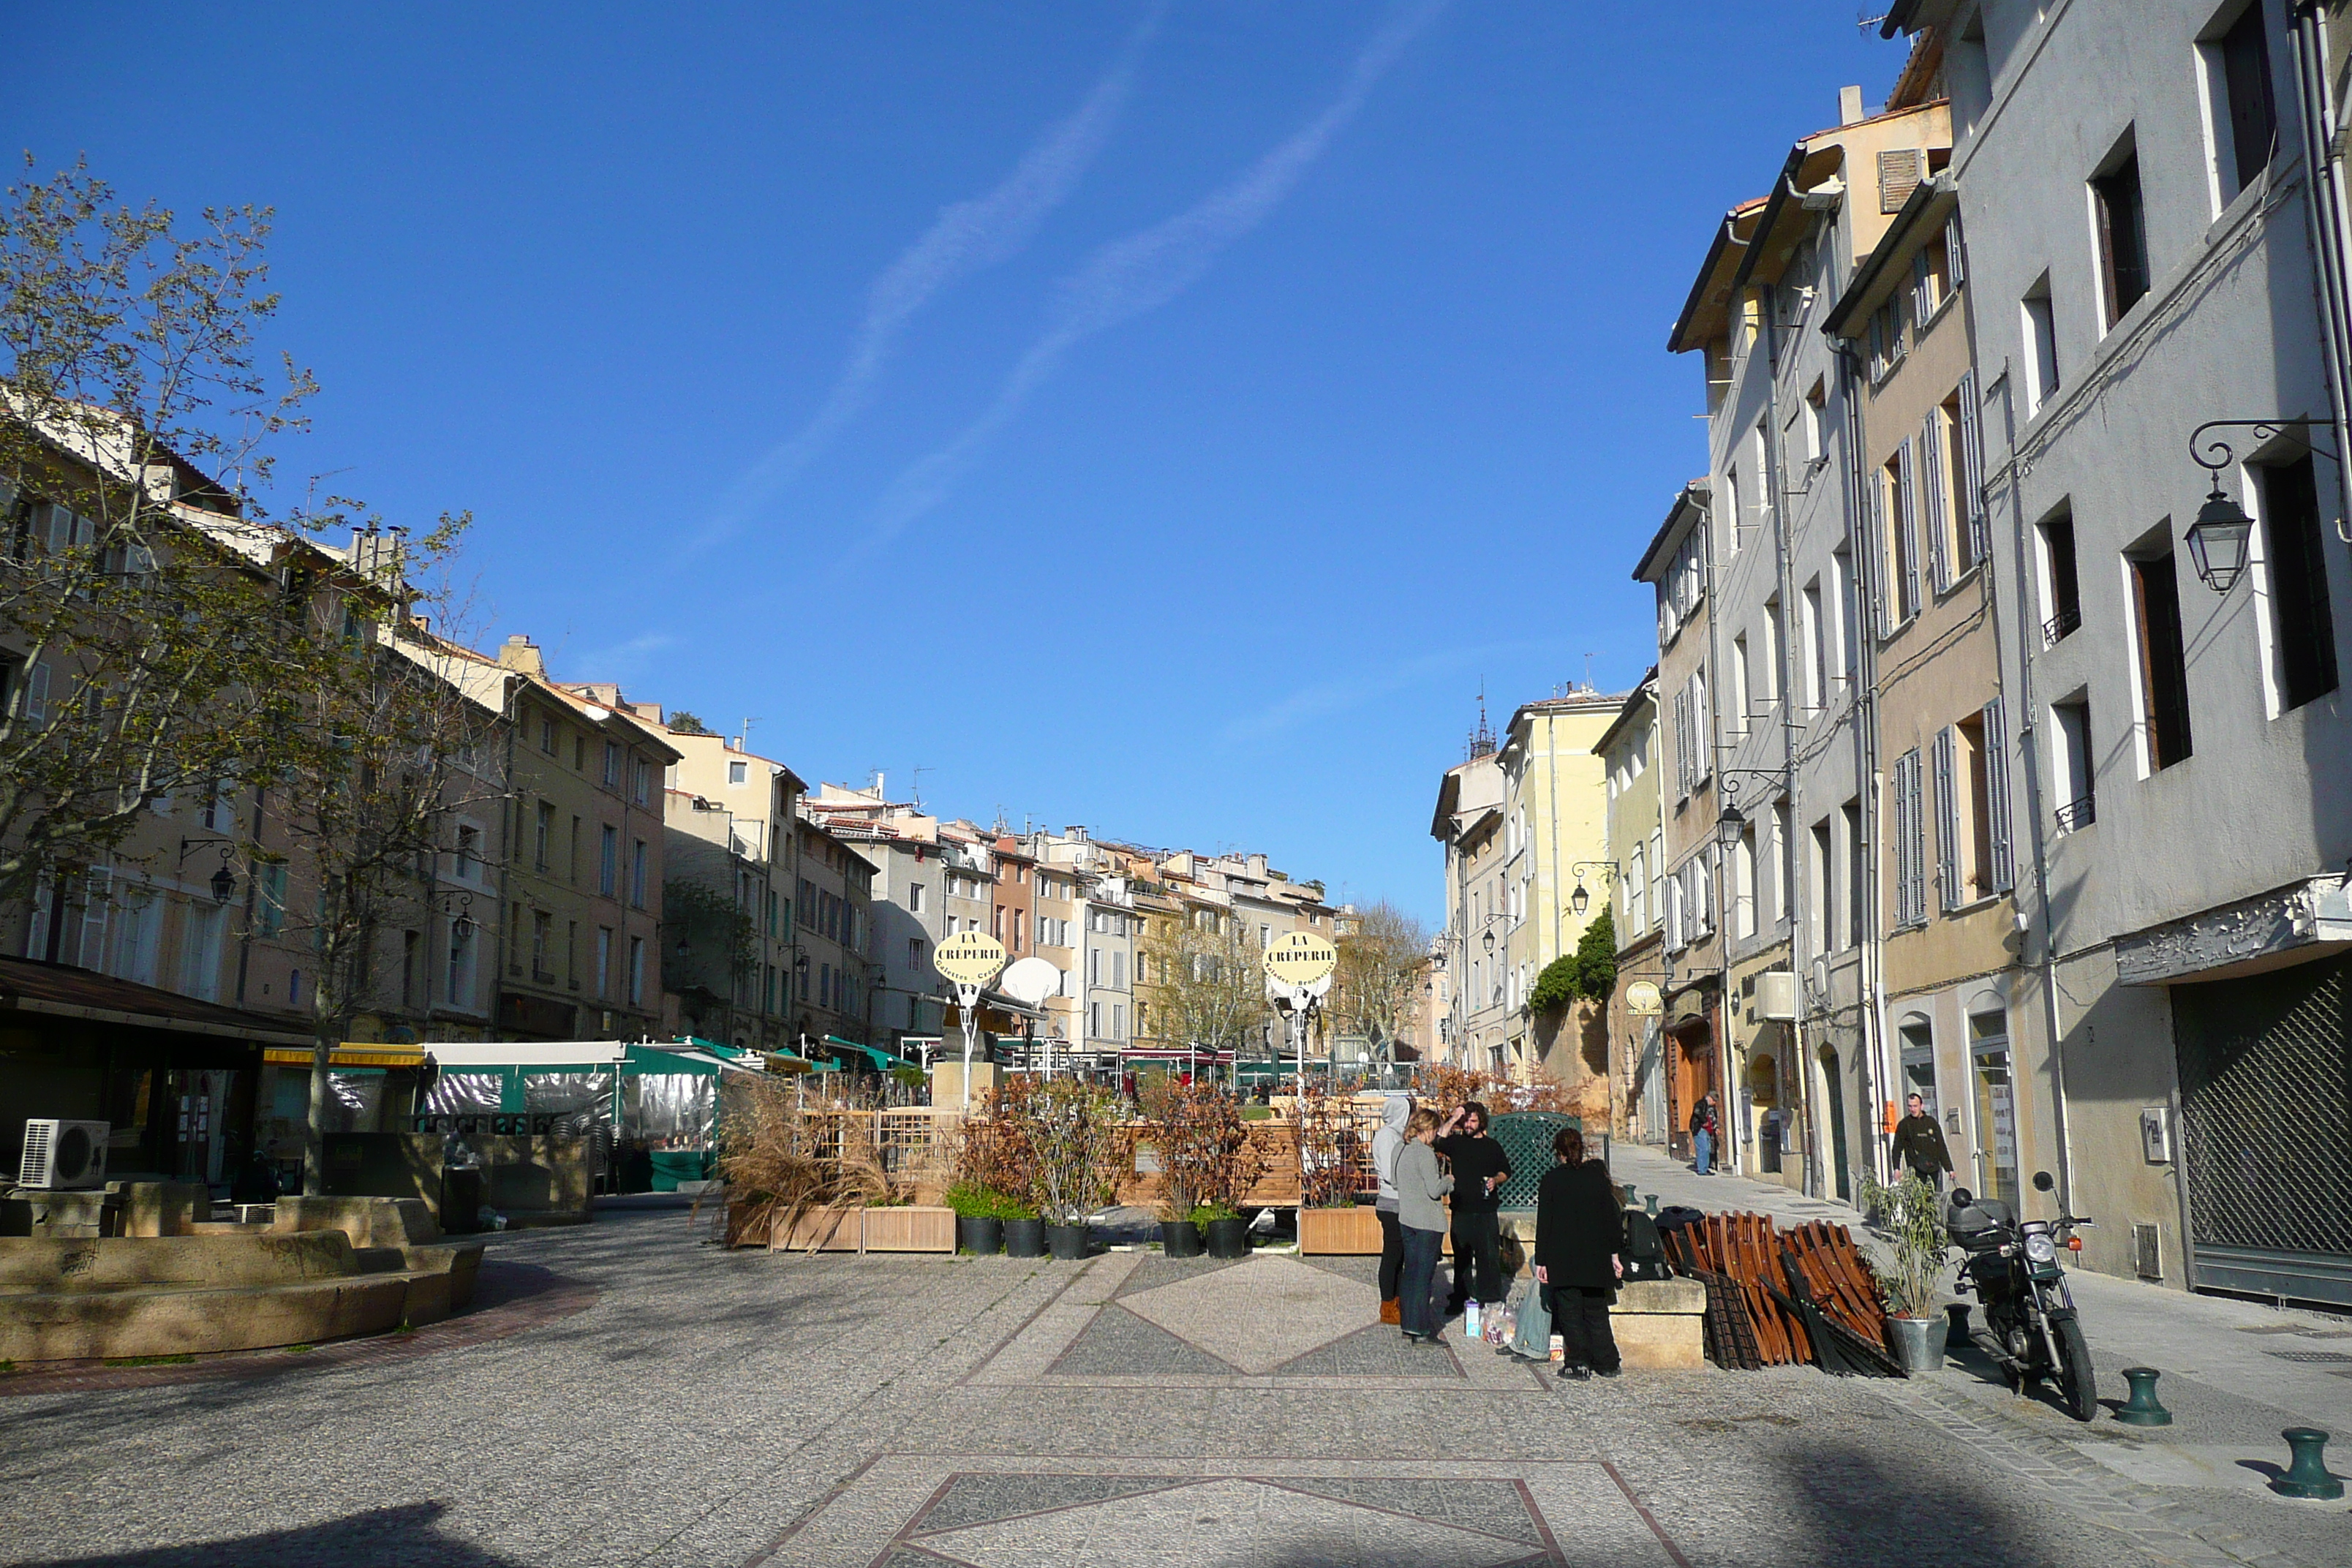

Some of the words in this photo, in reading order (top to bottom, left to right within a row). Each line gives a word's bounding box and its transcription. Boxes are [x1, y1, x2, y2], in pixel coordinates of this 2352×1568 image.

[961, 933, 977, 943] LA
[1292, 935, 1308, 946] LA
[938, 946, 1003, 960] CRÊPERIE
[1268, 949, 1335, 962] CRÊPERIE
[936, 960, 968, 981] Galettes
[1266, 962, 1289, 984] Salades
[1632, 988, 1656, 998] Pietra
